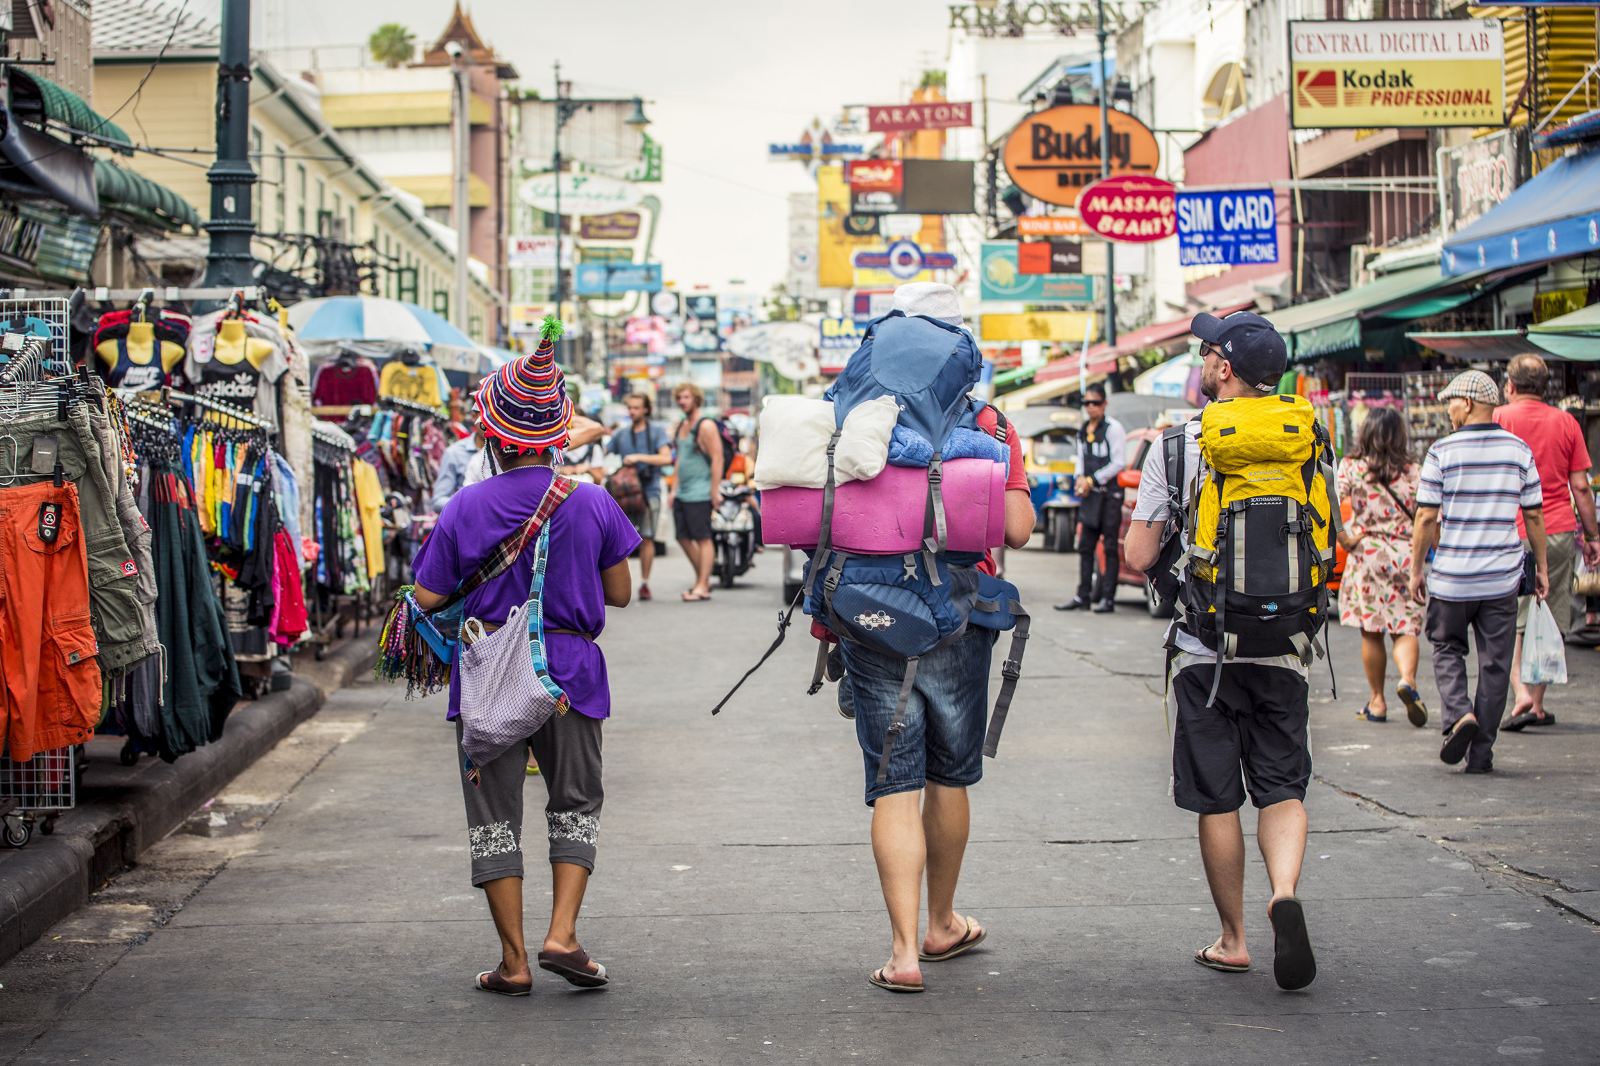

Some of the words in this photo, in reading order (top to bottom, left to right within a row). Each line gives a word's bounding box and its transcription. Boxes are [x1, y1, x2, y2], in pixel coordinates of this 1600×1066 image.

[1294, 33, 1373, 54] CENTRAL
[1380, 32, 1450, 53] DIGITAL
[1458, 31, 1490, 51] LAB
[1343, 70, 1414, 88] Kodak
[1370, 89, 1493, 106] PROFESSIONAL
[1422, 110, 1495, 118] PRODUCTS
[1032, 123, 1130, 168] Buddy
[1087, 195, 1175, 215] MASSAG
[1177, 197, 1214, 233] SIM
[1219, 195, 1274, 231] CARD
[1181, 246, 1224, 264] UNLOCK
[1240, 243, 1276, 262] PHONE
